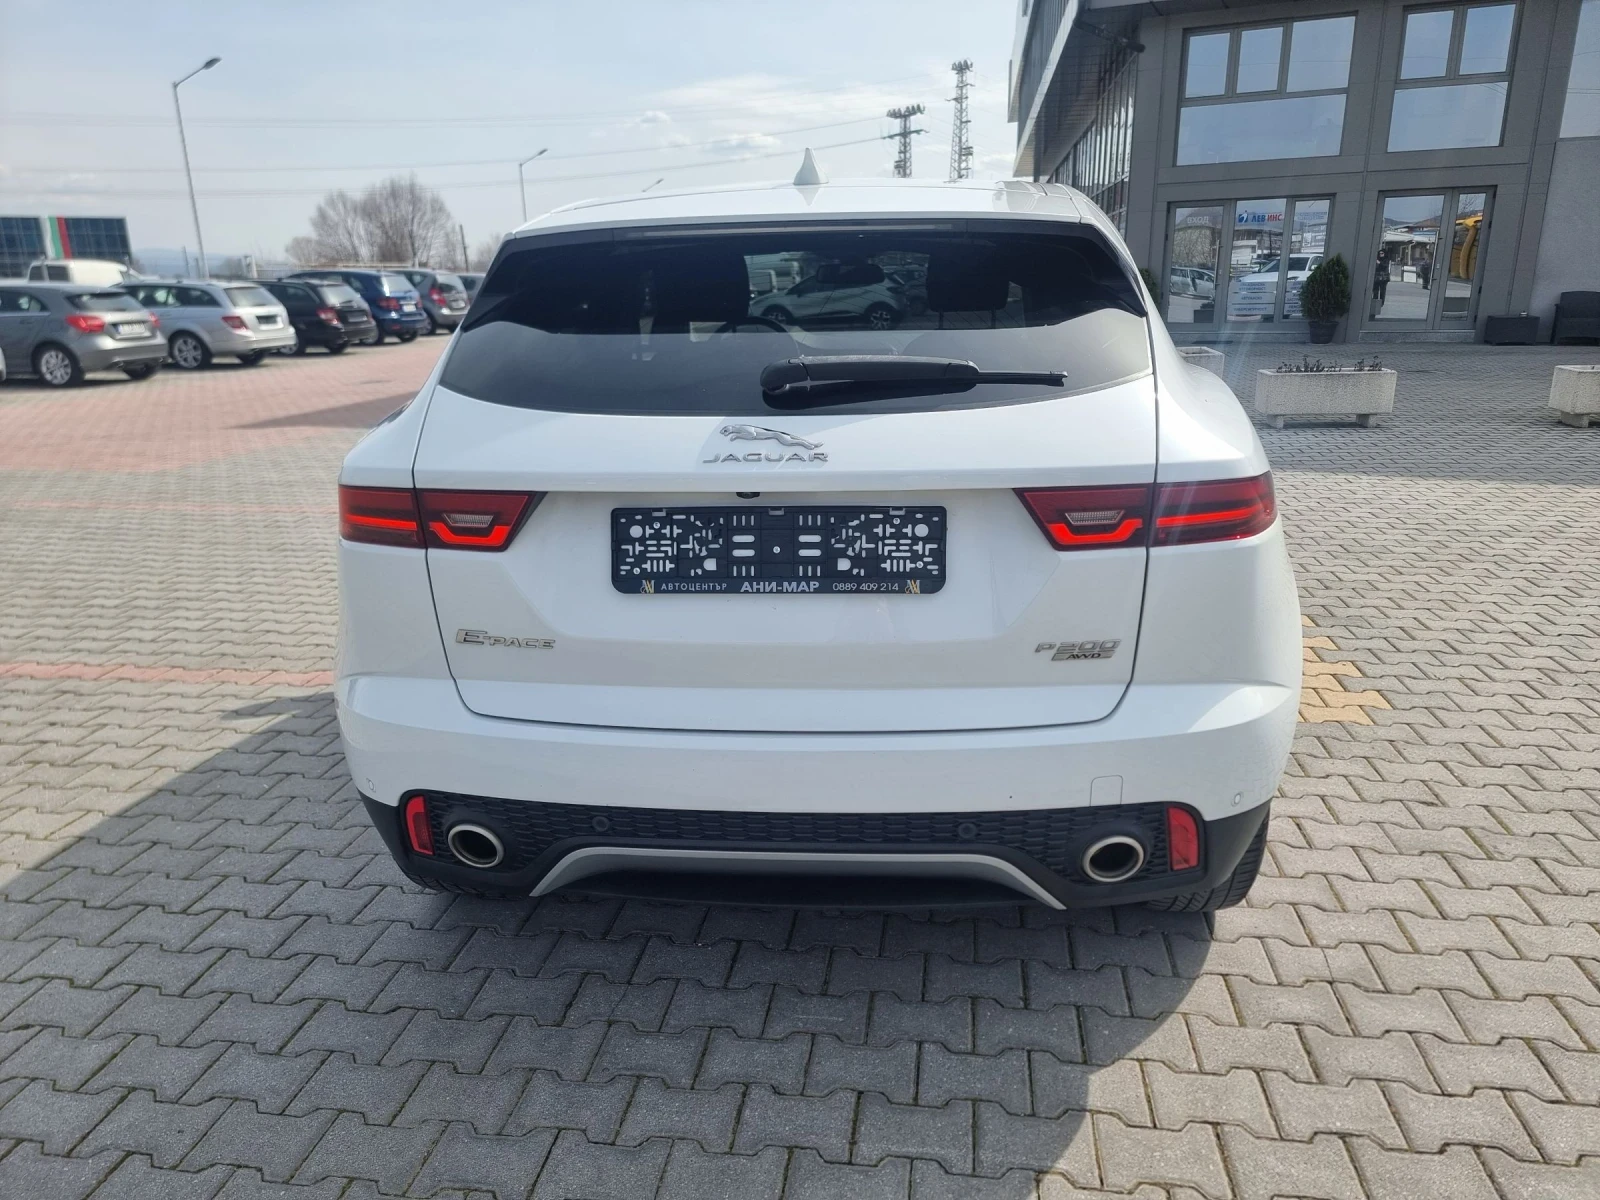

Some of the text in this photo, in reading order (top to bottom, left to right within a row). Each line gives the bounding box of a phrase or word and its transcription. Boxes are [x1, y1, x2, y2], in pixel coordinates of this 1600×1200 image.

[1187, 216, 1209, 224] ВХОД
[702, 453, 828, 463] JAGUAR
[660, 582, 728, 592] АВТОЦЕНТЪР
[740, 581, 820, 593] АНИ-МАР
[832, 582, 858, 592] 0889
[859, 582, 878, 592] 409
[880, 582, 899, 592] 214
